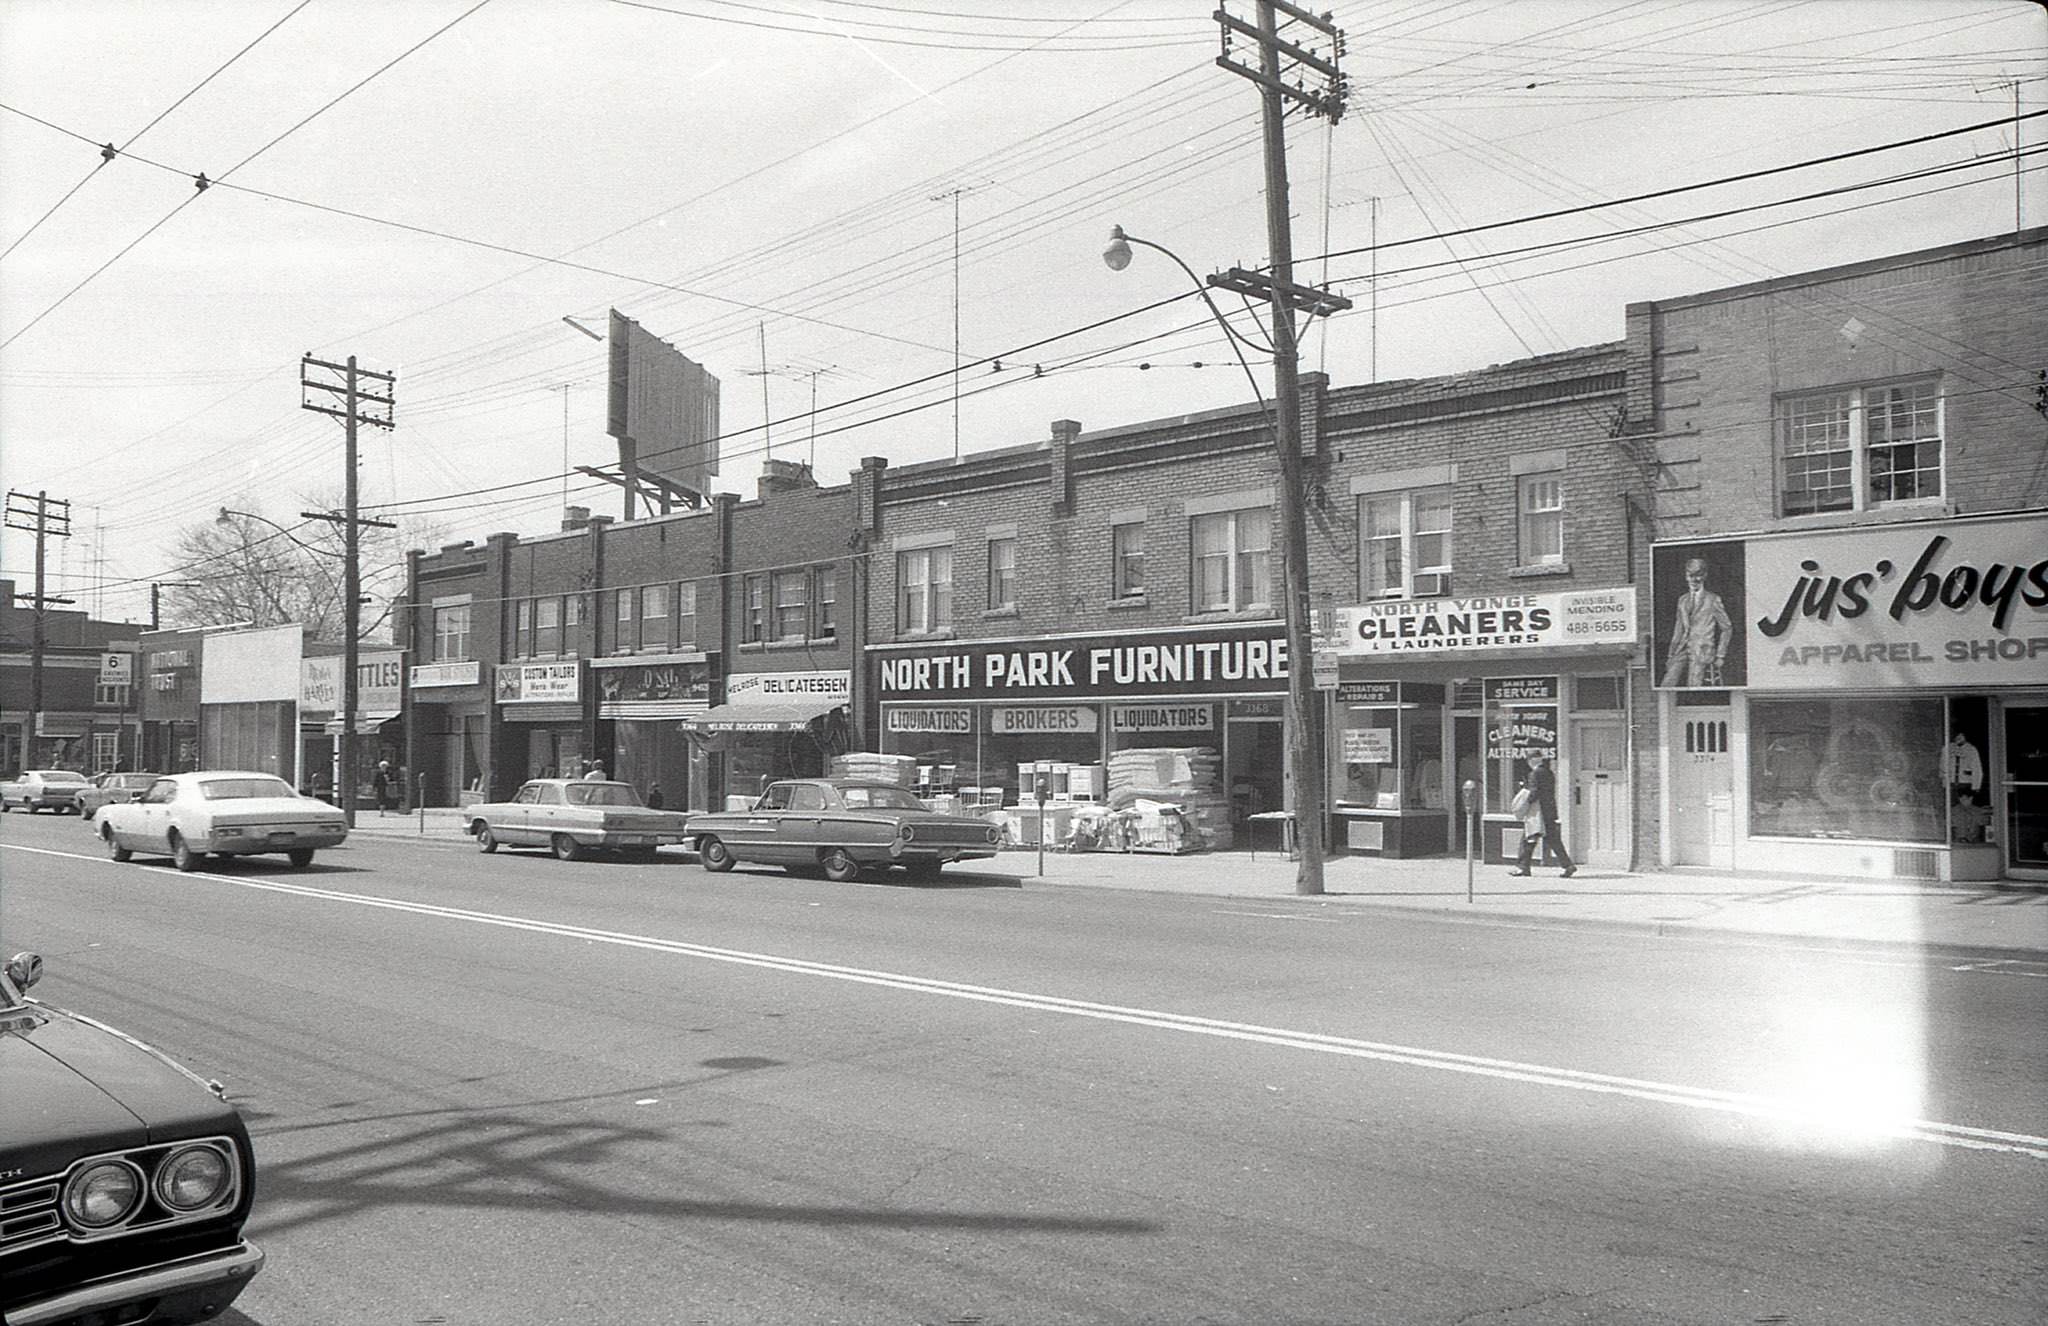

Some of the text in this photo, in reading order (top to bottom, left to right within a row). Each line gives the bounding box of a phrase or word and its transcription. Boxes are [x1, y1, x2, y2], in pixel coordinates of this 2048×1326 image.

[1757, 535, 2048, 638] jus' boys
[1370, 595, 1537, 617] NORTH YONGE
[1571, 596, 1617, 606] INVISIBLE
[1566, 604, 1625, 615] MENDING
[1358, 609, 1552, 641] CLEANERS
[1566, 620, 1627, 634] 488-5655
[1391, 634, 1539, 650] LAUNDERERS
[1778, 637, 2048, 666] APPAREL SHOP
[109, 655, 118, 668] 6
[881, 655, 971, 691] NORTH
[985, 650, 1075, 688] PARK
[1090, 639, 1289, 685] FURNITURE
[549, 665, 575, 678] TAILORS
[728, 677, 759, 693] MELROSE
[763, 678, 848, 693] DELICATESSEN
[1340, 685, 1391, 693] ALTERATIONS
[1494, 687, 1549, 698] SERVICE
[1347, 693, 1384, 701] REPAIRS
[890, 710, 970, 731] LIQUIDATORS
[1004, 709, 1080, 730] BROKERS
[1113, 708, 1208, 728] LIQUIDATORS
[1488, 725, 1556, 742] CLEANERS
[1487, 747, 1556, 759] ALTERATNS
